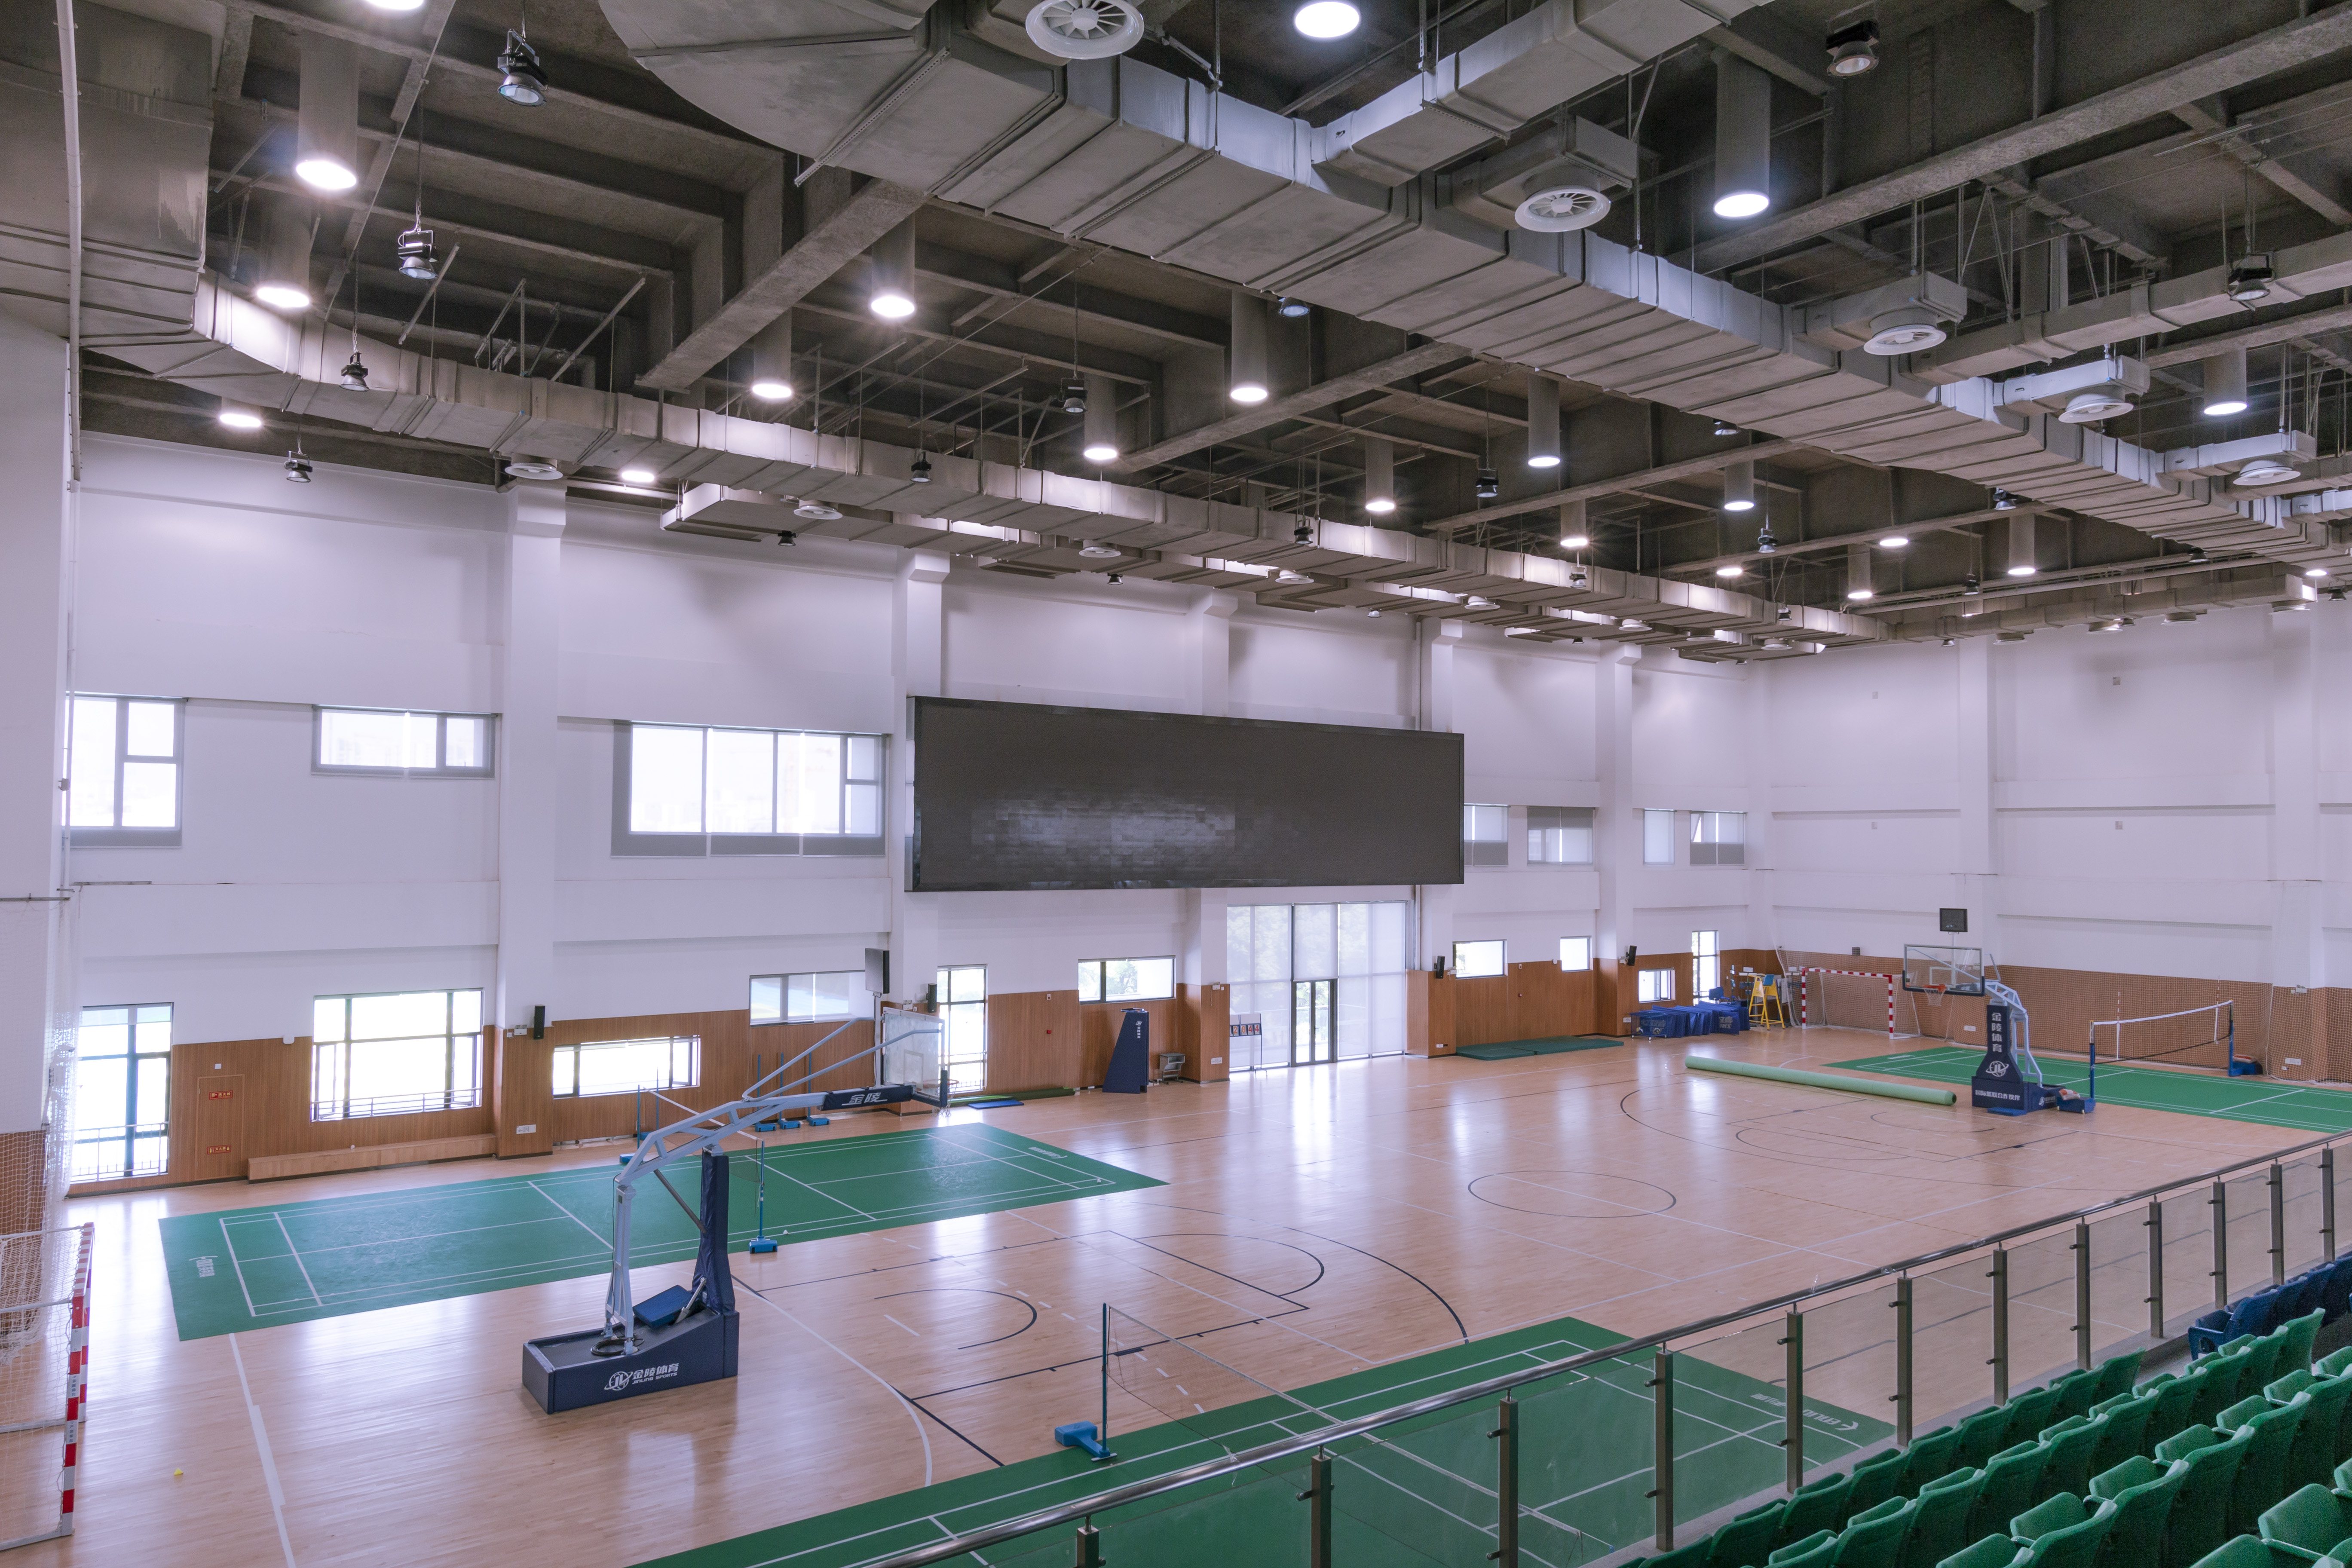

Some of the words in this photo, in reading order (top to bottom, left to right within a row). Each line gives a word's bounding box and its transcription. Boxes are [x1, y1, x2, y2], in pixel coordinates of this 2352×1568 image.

[1991, 1012, 2003, 1053] 金陵体育
[842, 1092, 888, 1106] 金陵
[632, 1363, 679, 1380] 金陵体育
